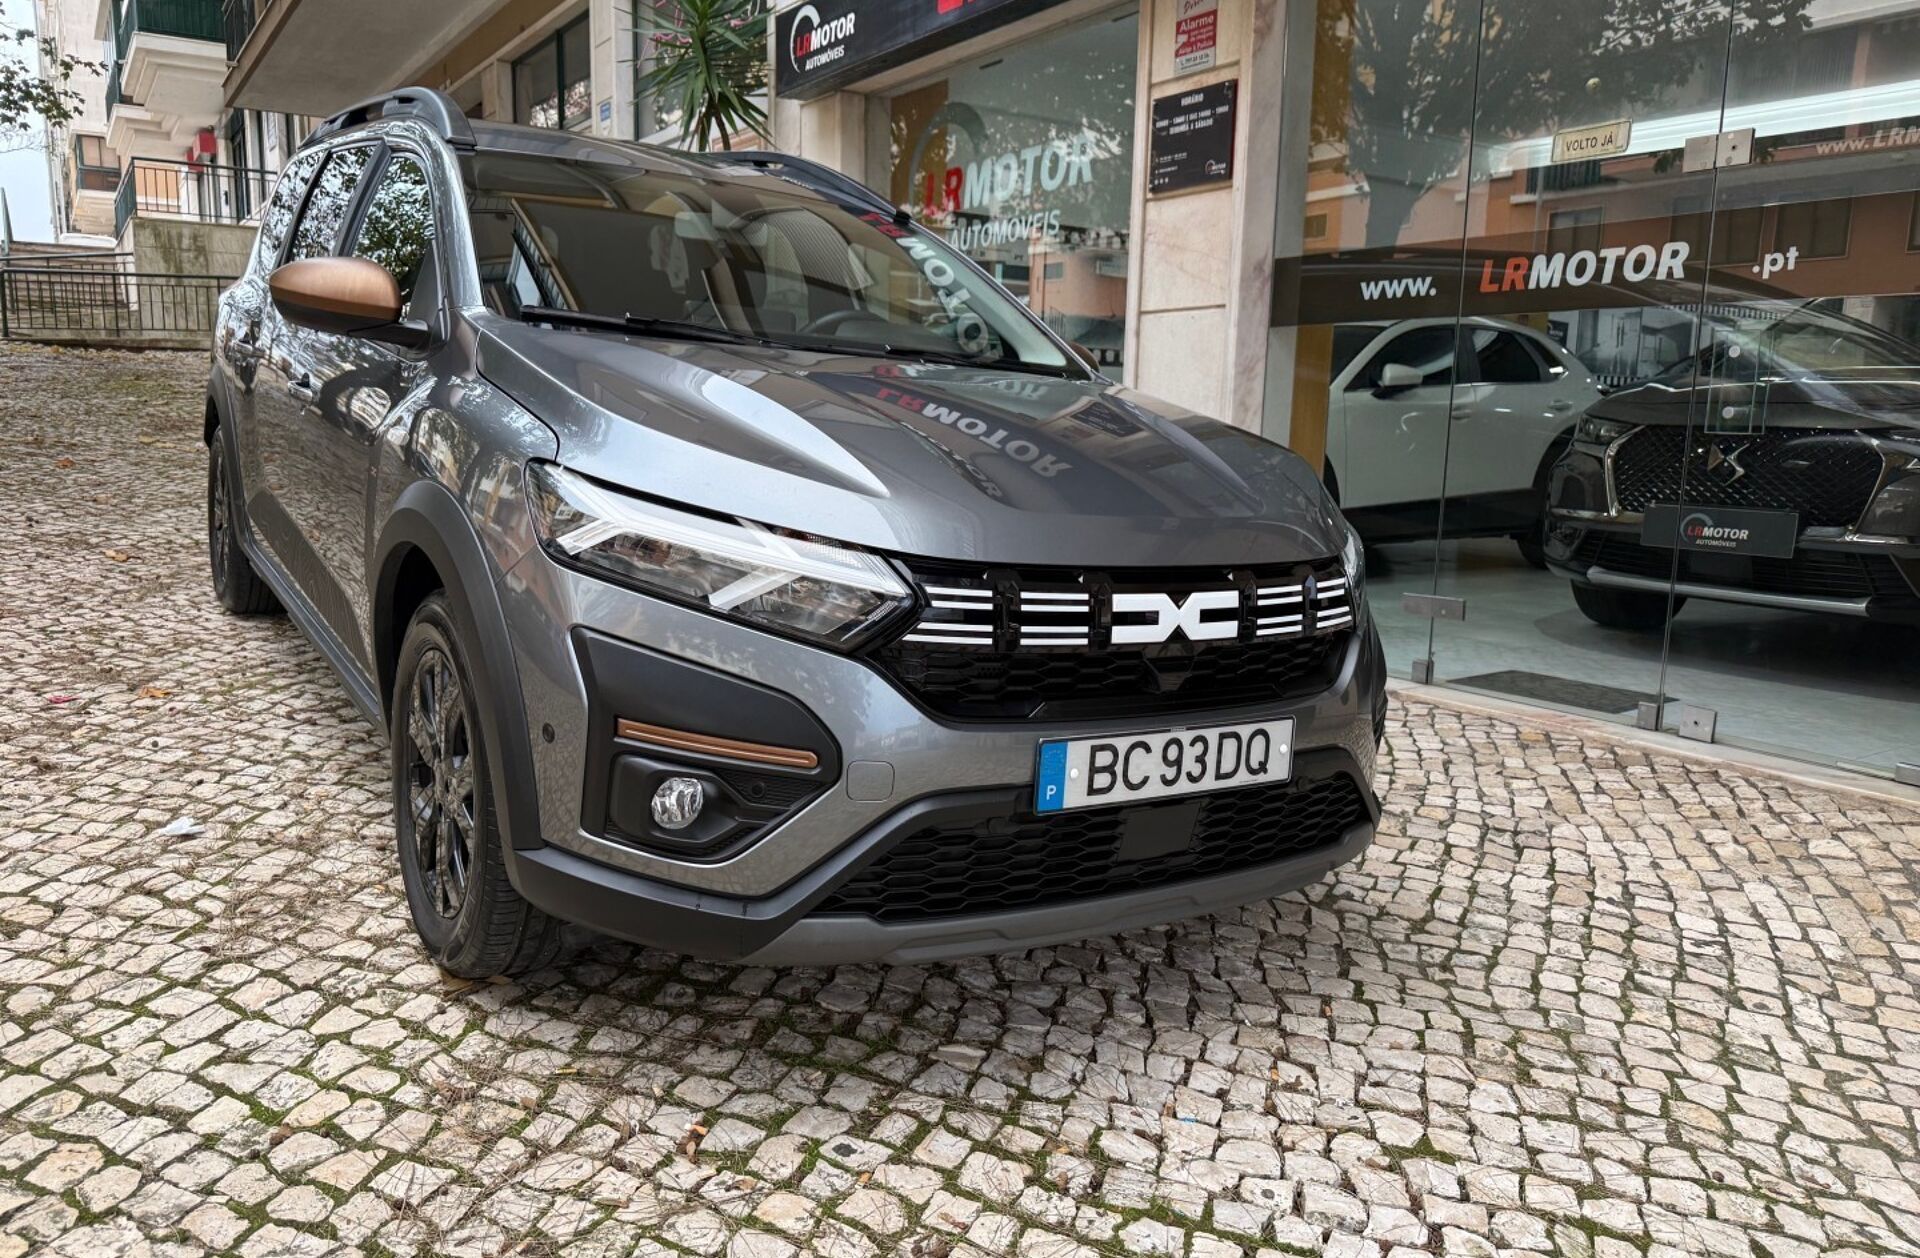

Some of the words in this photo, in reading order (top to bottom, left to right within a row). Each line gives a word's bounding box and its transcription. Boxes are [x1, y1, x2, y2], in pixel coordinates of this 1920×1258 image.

[1180, 15, 1214, 32] Alarme
[796, 12, 856, 57] LRMOTOR
[805, 44, 845, 71] AUTOMÓVEIS
[1566, 137, 1598, 151] VOLTO
[1601, 131, 1613, 146] JÁ
[1816, 139, 1869, 154] www.
[924, 133, 1092, 216] LRMOTOR
[1360, 277, 1436, 300] www.
[1480, 241, 1690, 293] LRMOTOR
[1752, 246, 1799, 279] .pt
[1687, 525, 1749, 540] LRMOTOR
[1046, 784, 1057, 801] P
